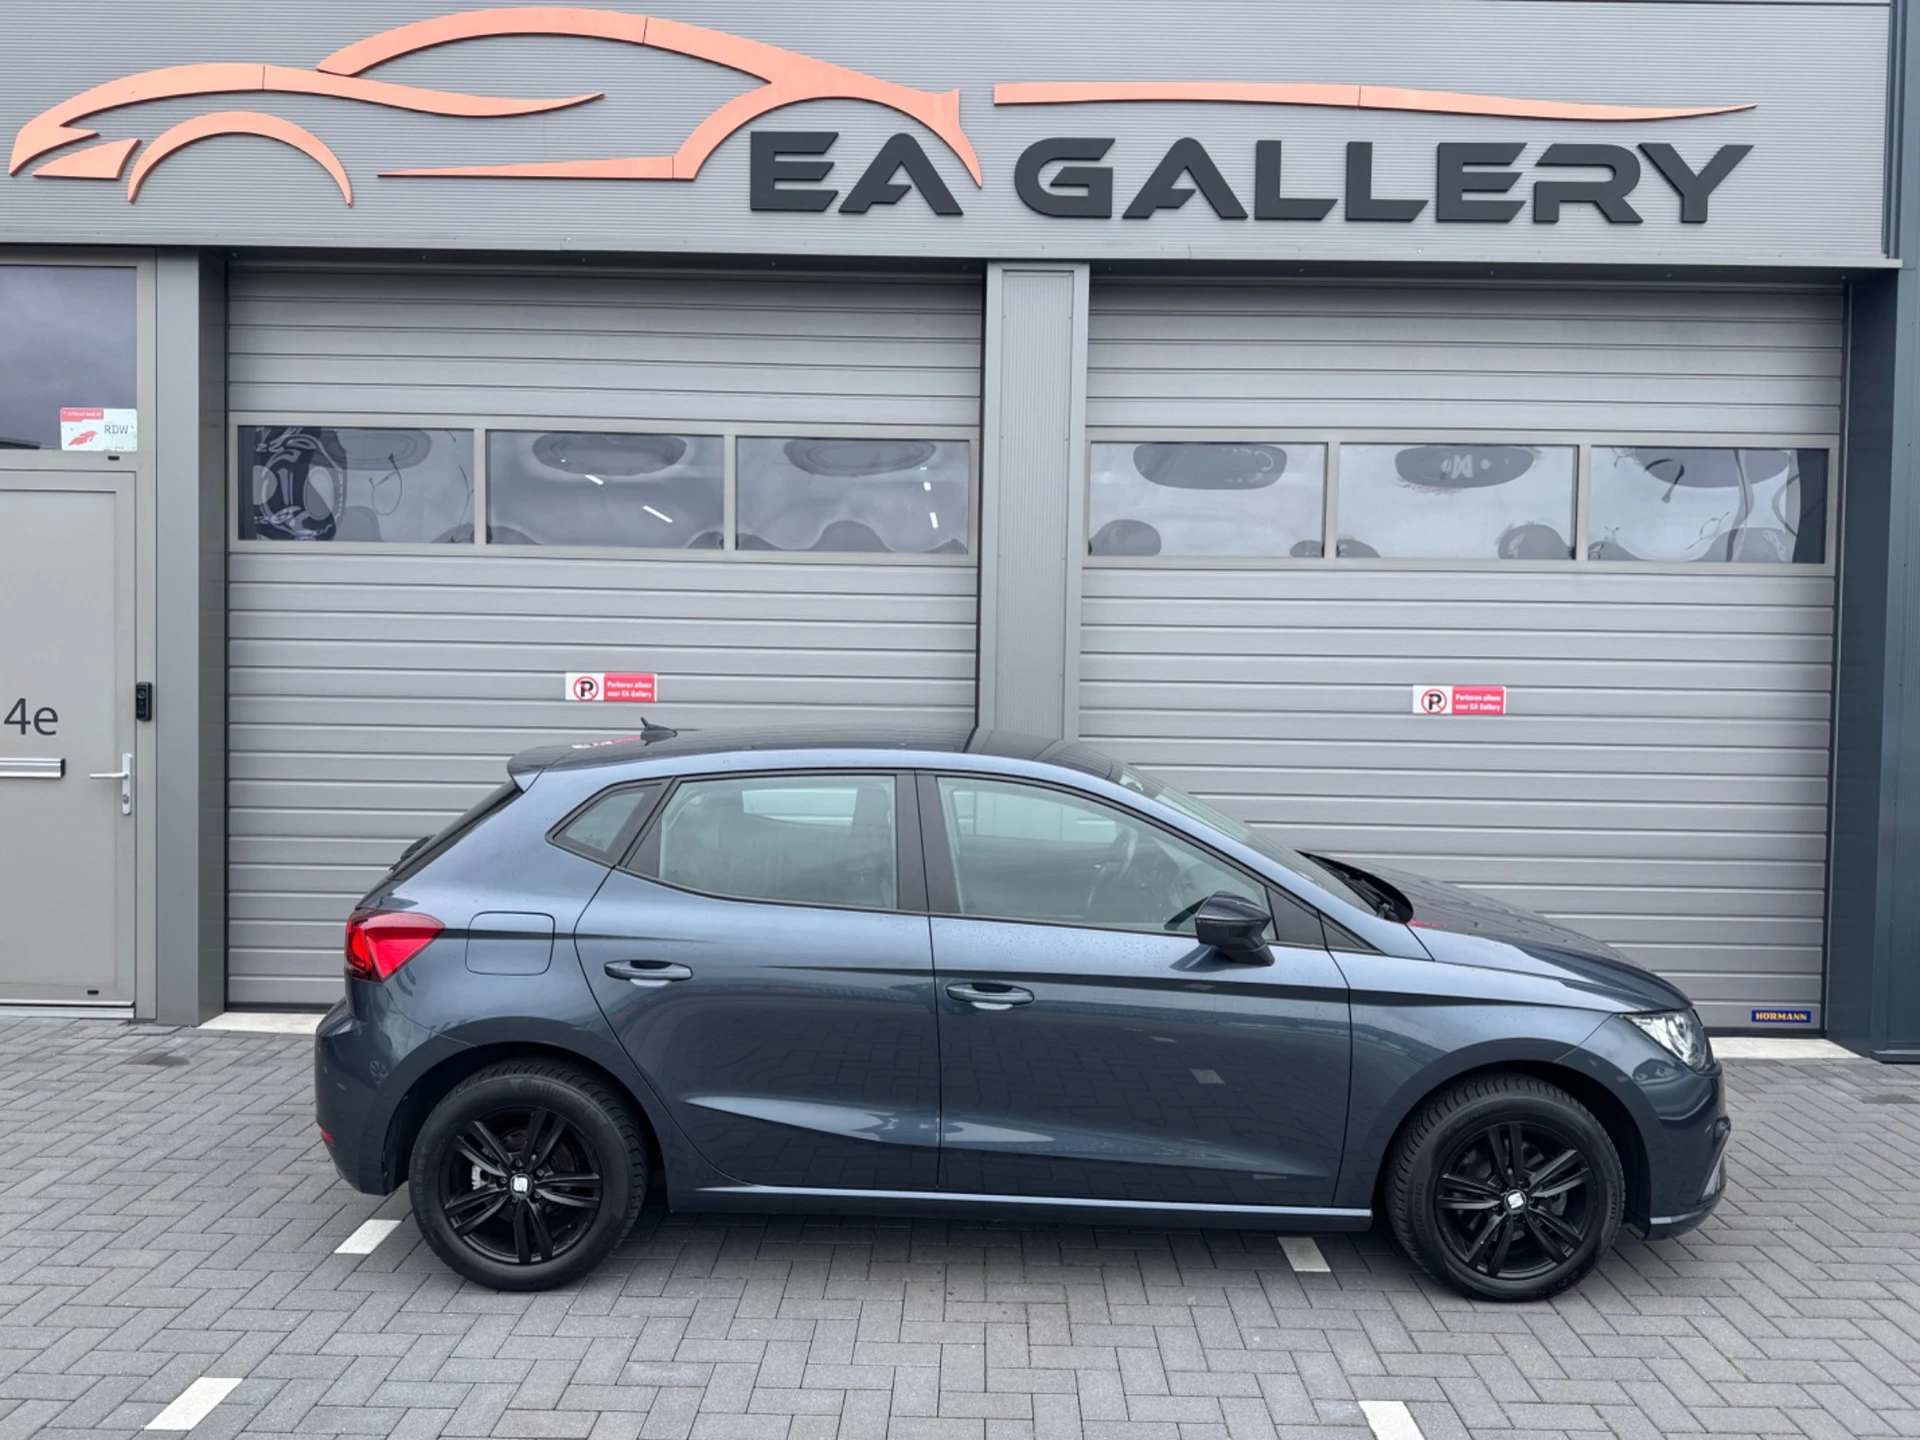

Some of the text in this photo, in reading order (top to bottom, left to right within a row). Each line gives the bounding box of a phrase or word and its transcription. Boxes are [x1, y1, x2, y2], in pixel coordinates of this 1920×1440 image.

[750, 131, 1755, 225] EA GALLERY
[104, 424, 129, 435] RDW
[3, 697, 59, 736] 4e
